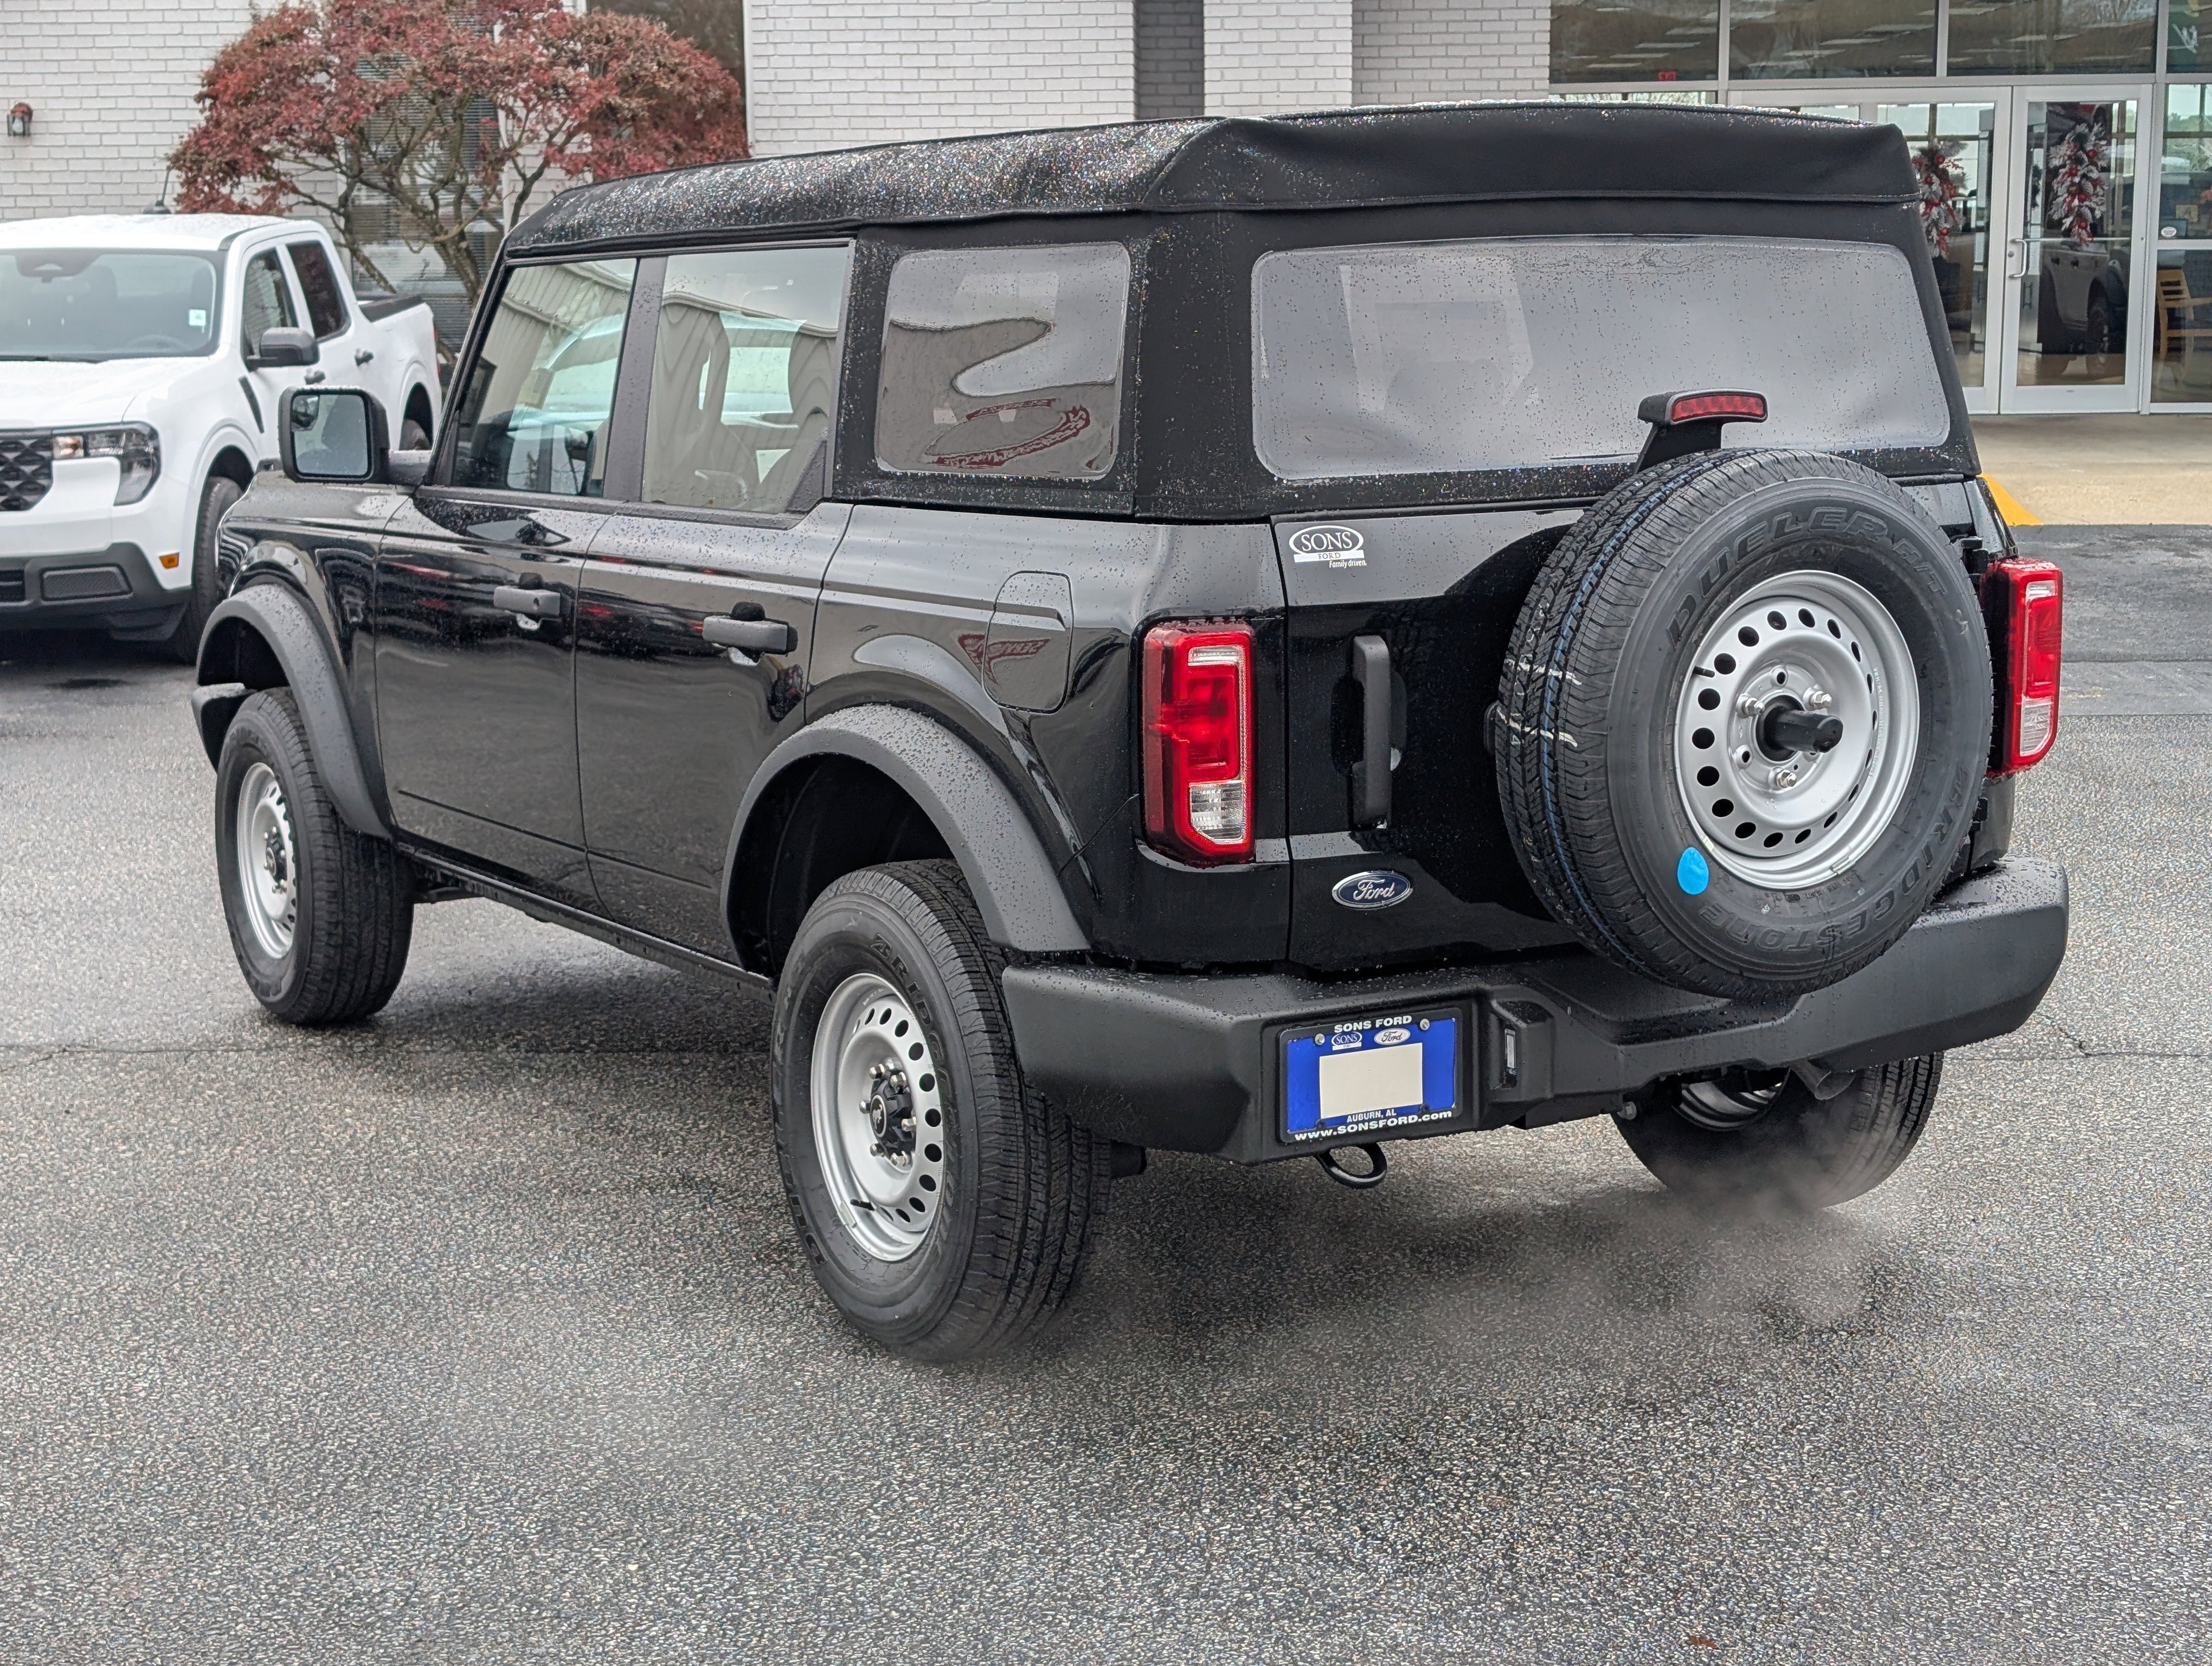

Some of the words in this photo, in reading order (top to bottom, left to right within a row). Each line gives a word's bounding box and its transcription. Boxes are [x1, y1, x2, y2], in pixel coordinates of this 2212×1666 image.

[1301, 531, 1353, 552] SONS
[1329, 560, 1348, 569] Family
[1348, 559, 1367, 567] driven.
[1666, 505, 1888, 650] DUELER
[1353, 879, 1396, 901] Ford
[1334, 1020, 1372, 1033] SONS
[1375, 1015, 1412, 1028] FORD
[1336, 1033, 1358, 1045] SONS
[1381, 1030, 1403, 1042] Ford
[1294, 1111, 1452, 1141] www.SONSFORD.com
[1346, 1111, 1384, 1124] AUBURN,
